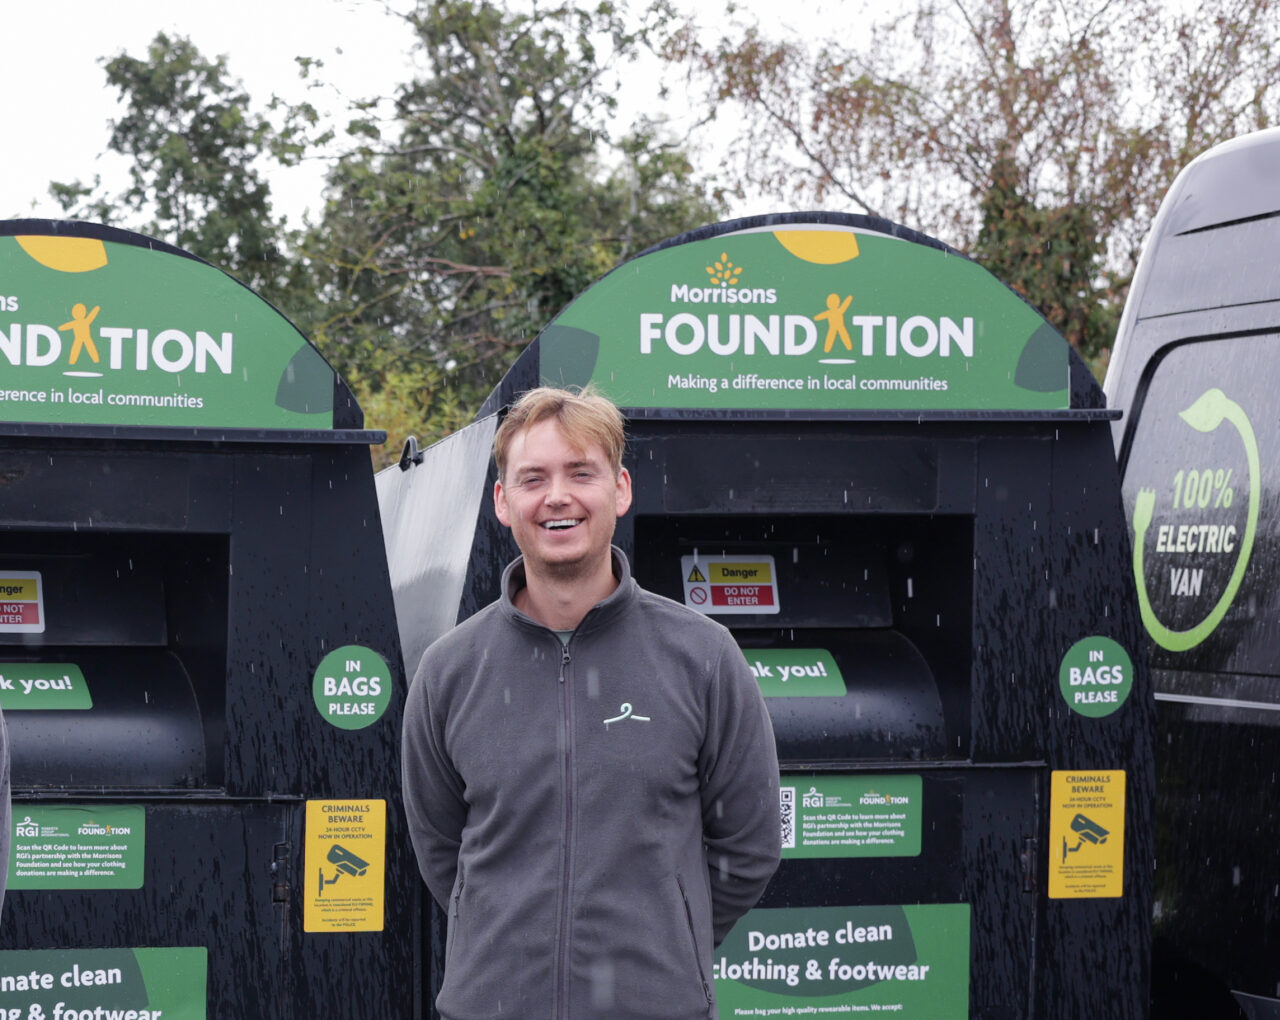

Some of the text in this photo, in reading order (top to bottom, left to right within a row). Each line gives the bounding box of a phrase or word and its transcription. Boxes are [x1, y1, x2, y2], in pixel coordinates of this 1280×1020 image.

[671, 285, 776, 303] Morrisons
[668, 374, 948, 392] Making a difference in local communities
[50, 389, 65, 402] in
[69, 388, 103, 404] local
[108, 393, 203, 408] communities
[1173, 469, 1233, 508] 100%
[1156, 524, 1237, 553] ELECTRIC
[721, 568, 758, 578] Danger
[1171, 568, 1203, 596] VAN
[724, 587, 760, 596] DO NOT
[727, 596, 759, 605] ENTER
[3, 604, 24, 613] NOT
[1089, 651, 1104, 662] IN
[345, 661, 361, 672] IN
[777, 662, 827, 681] you!
[1070, 666, 1123, 685] BAGS
[19, 676, 72, 694] you!
[324, 677, 381, 696] BAGS
[1074, 691, 1118, 703] PLEASE
[328, 703, 376, 714] PLEASE
[1065, 775, 1111, 783] CRIMINALS
[1071, 785, 1105, 794] BEWARE
[802, 796, 824, 807] RGI
[321, 804, 370, 813] CRIMINALS
[327, 815, 364, 824] BEWARE
[15, 826, 39, 836] RGI
[749, 921, 893, 951] Donate clean
[805, 960, 822, 980] &
[829, 958, 929, 980] footwear
[61, 964, 121, 987] clean
